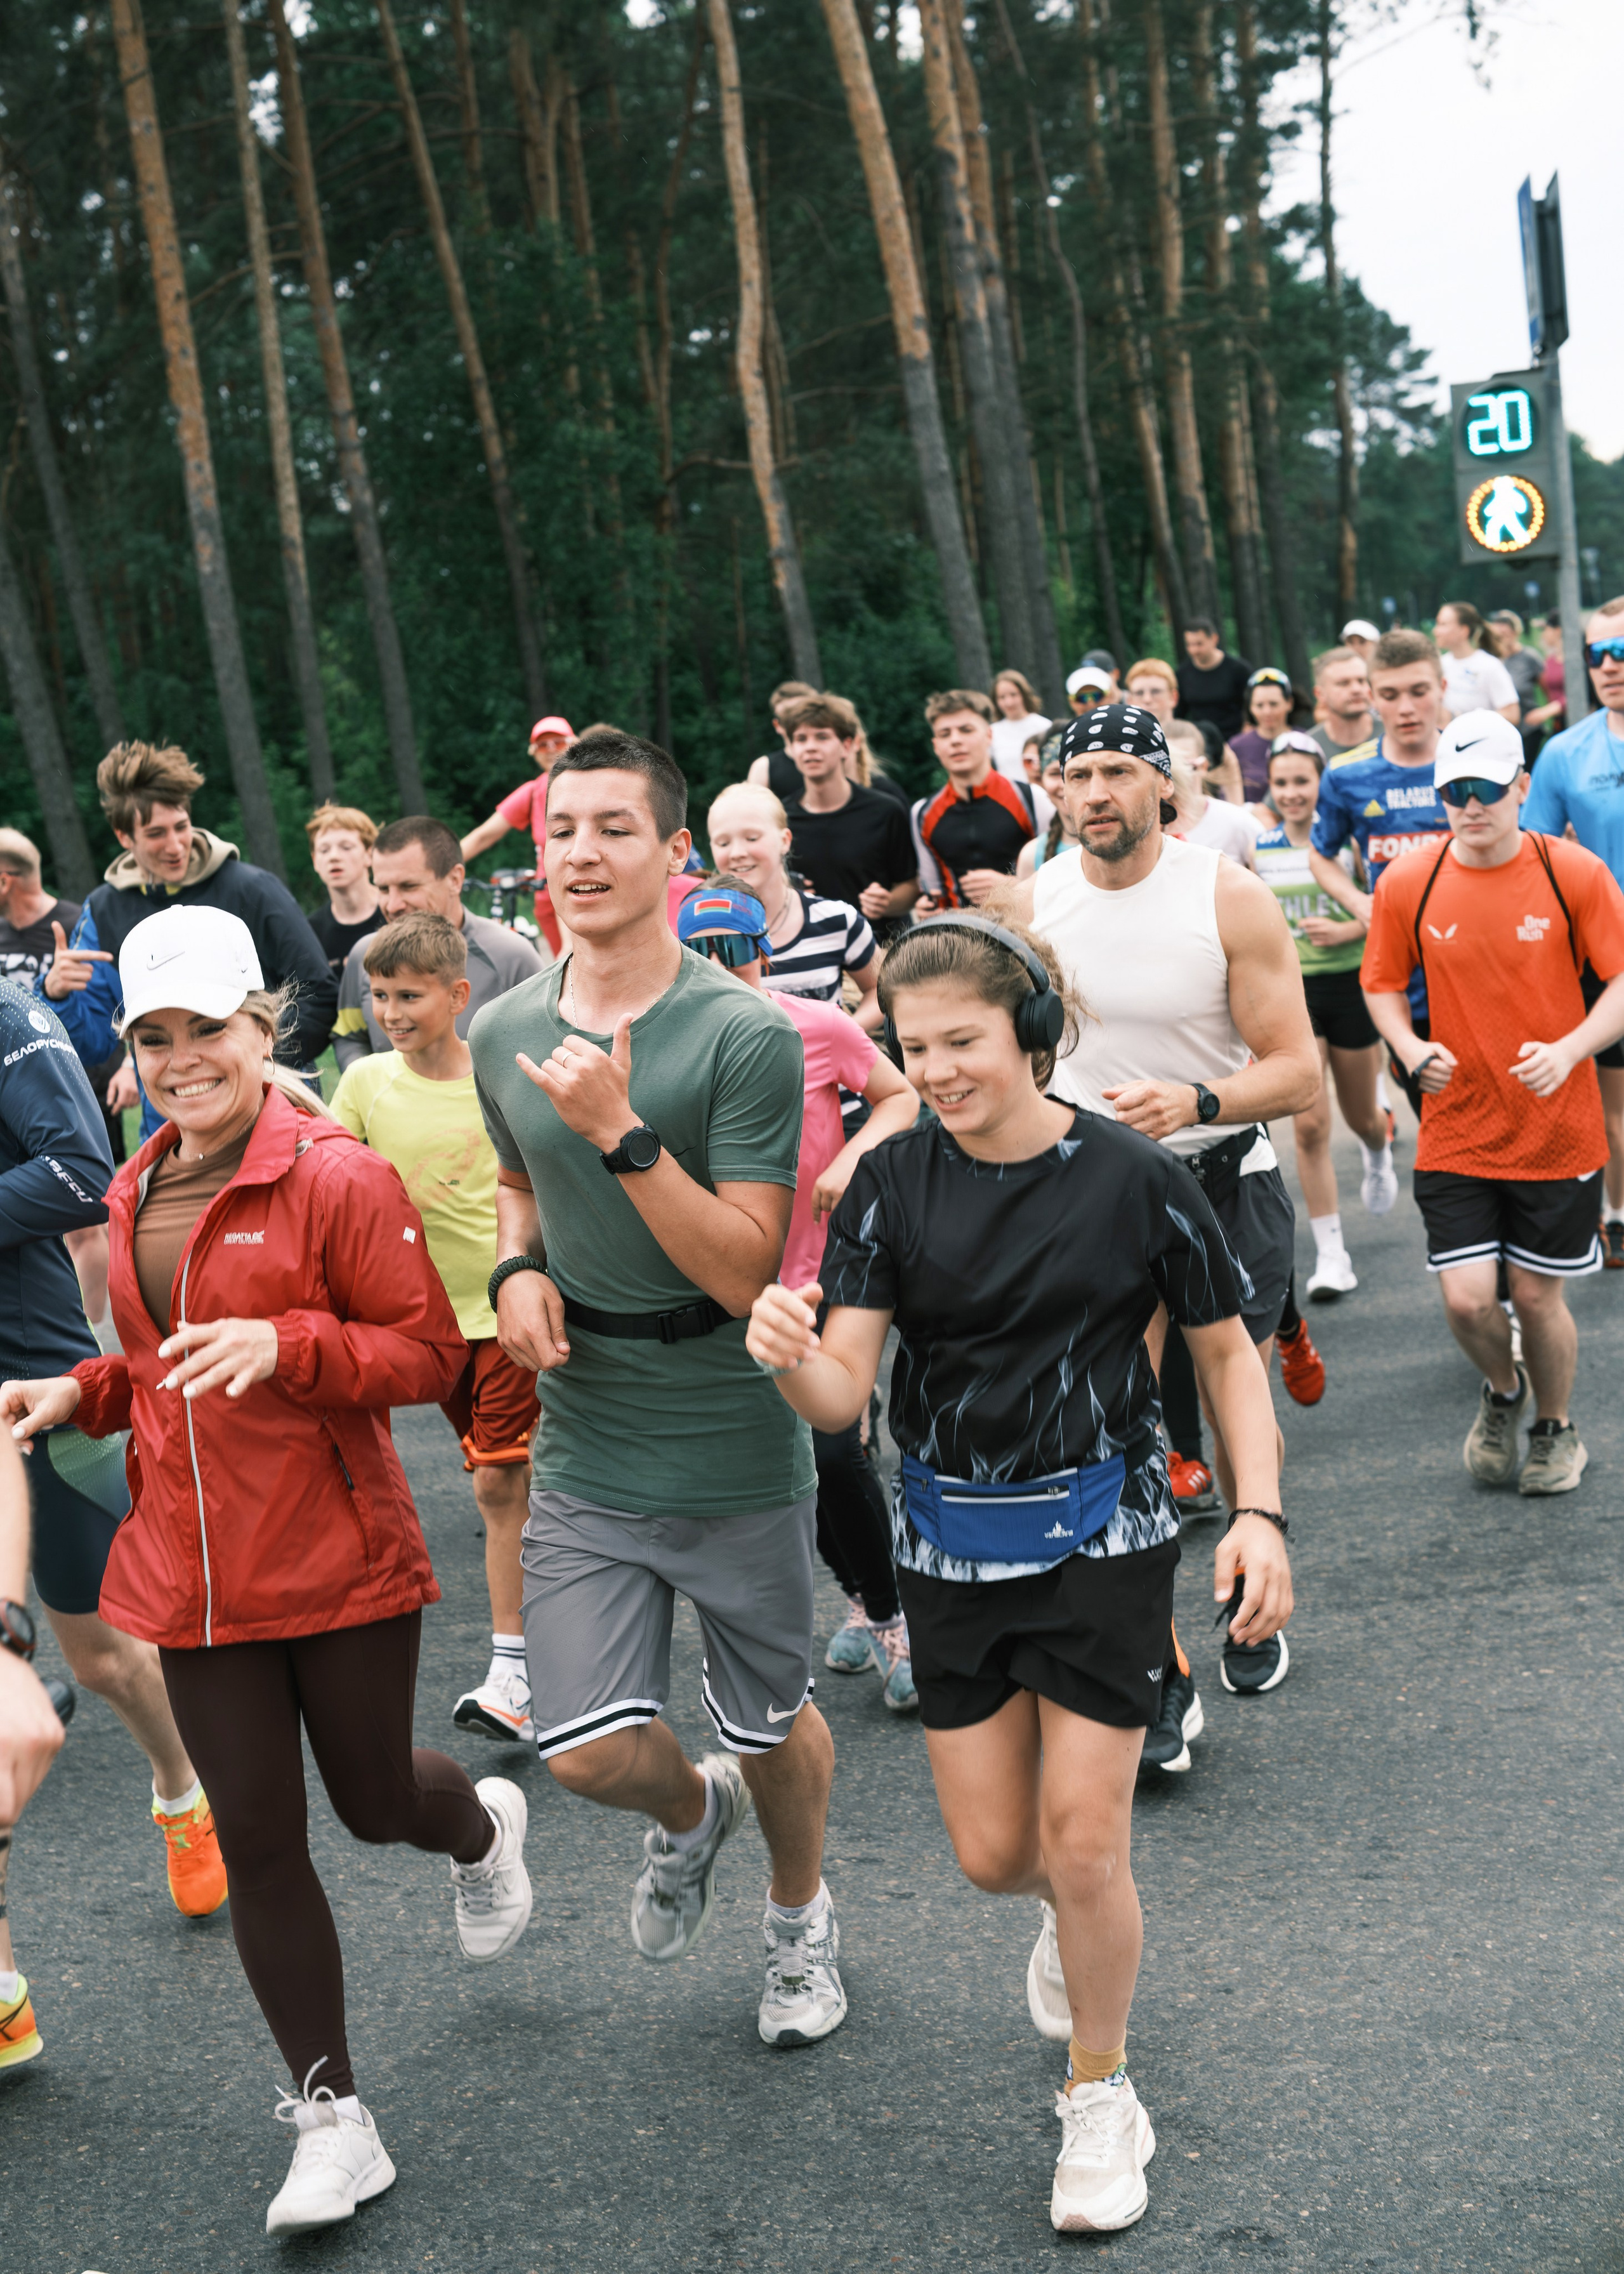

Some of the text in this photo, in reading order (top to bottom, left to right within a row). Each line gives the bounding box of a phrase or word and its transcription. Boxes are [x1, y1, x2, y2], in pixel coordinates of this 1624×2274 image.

[1468, 388, 1532, 456] 20
[1368, 833, 1449, 860] FON
[1524, 914, 1550, 930] One
